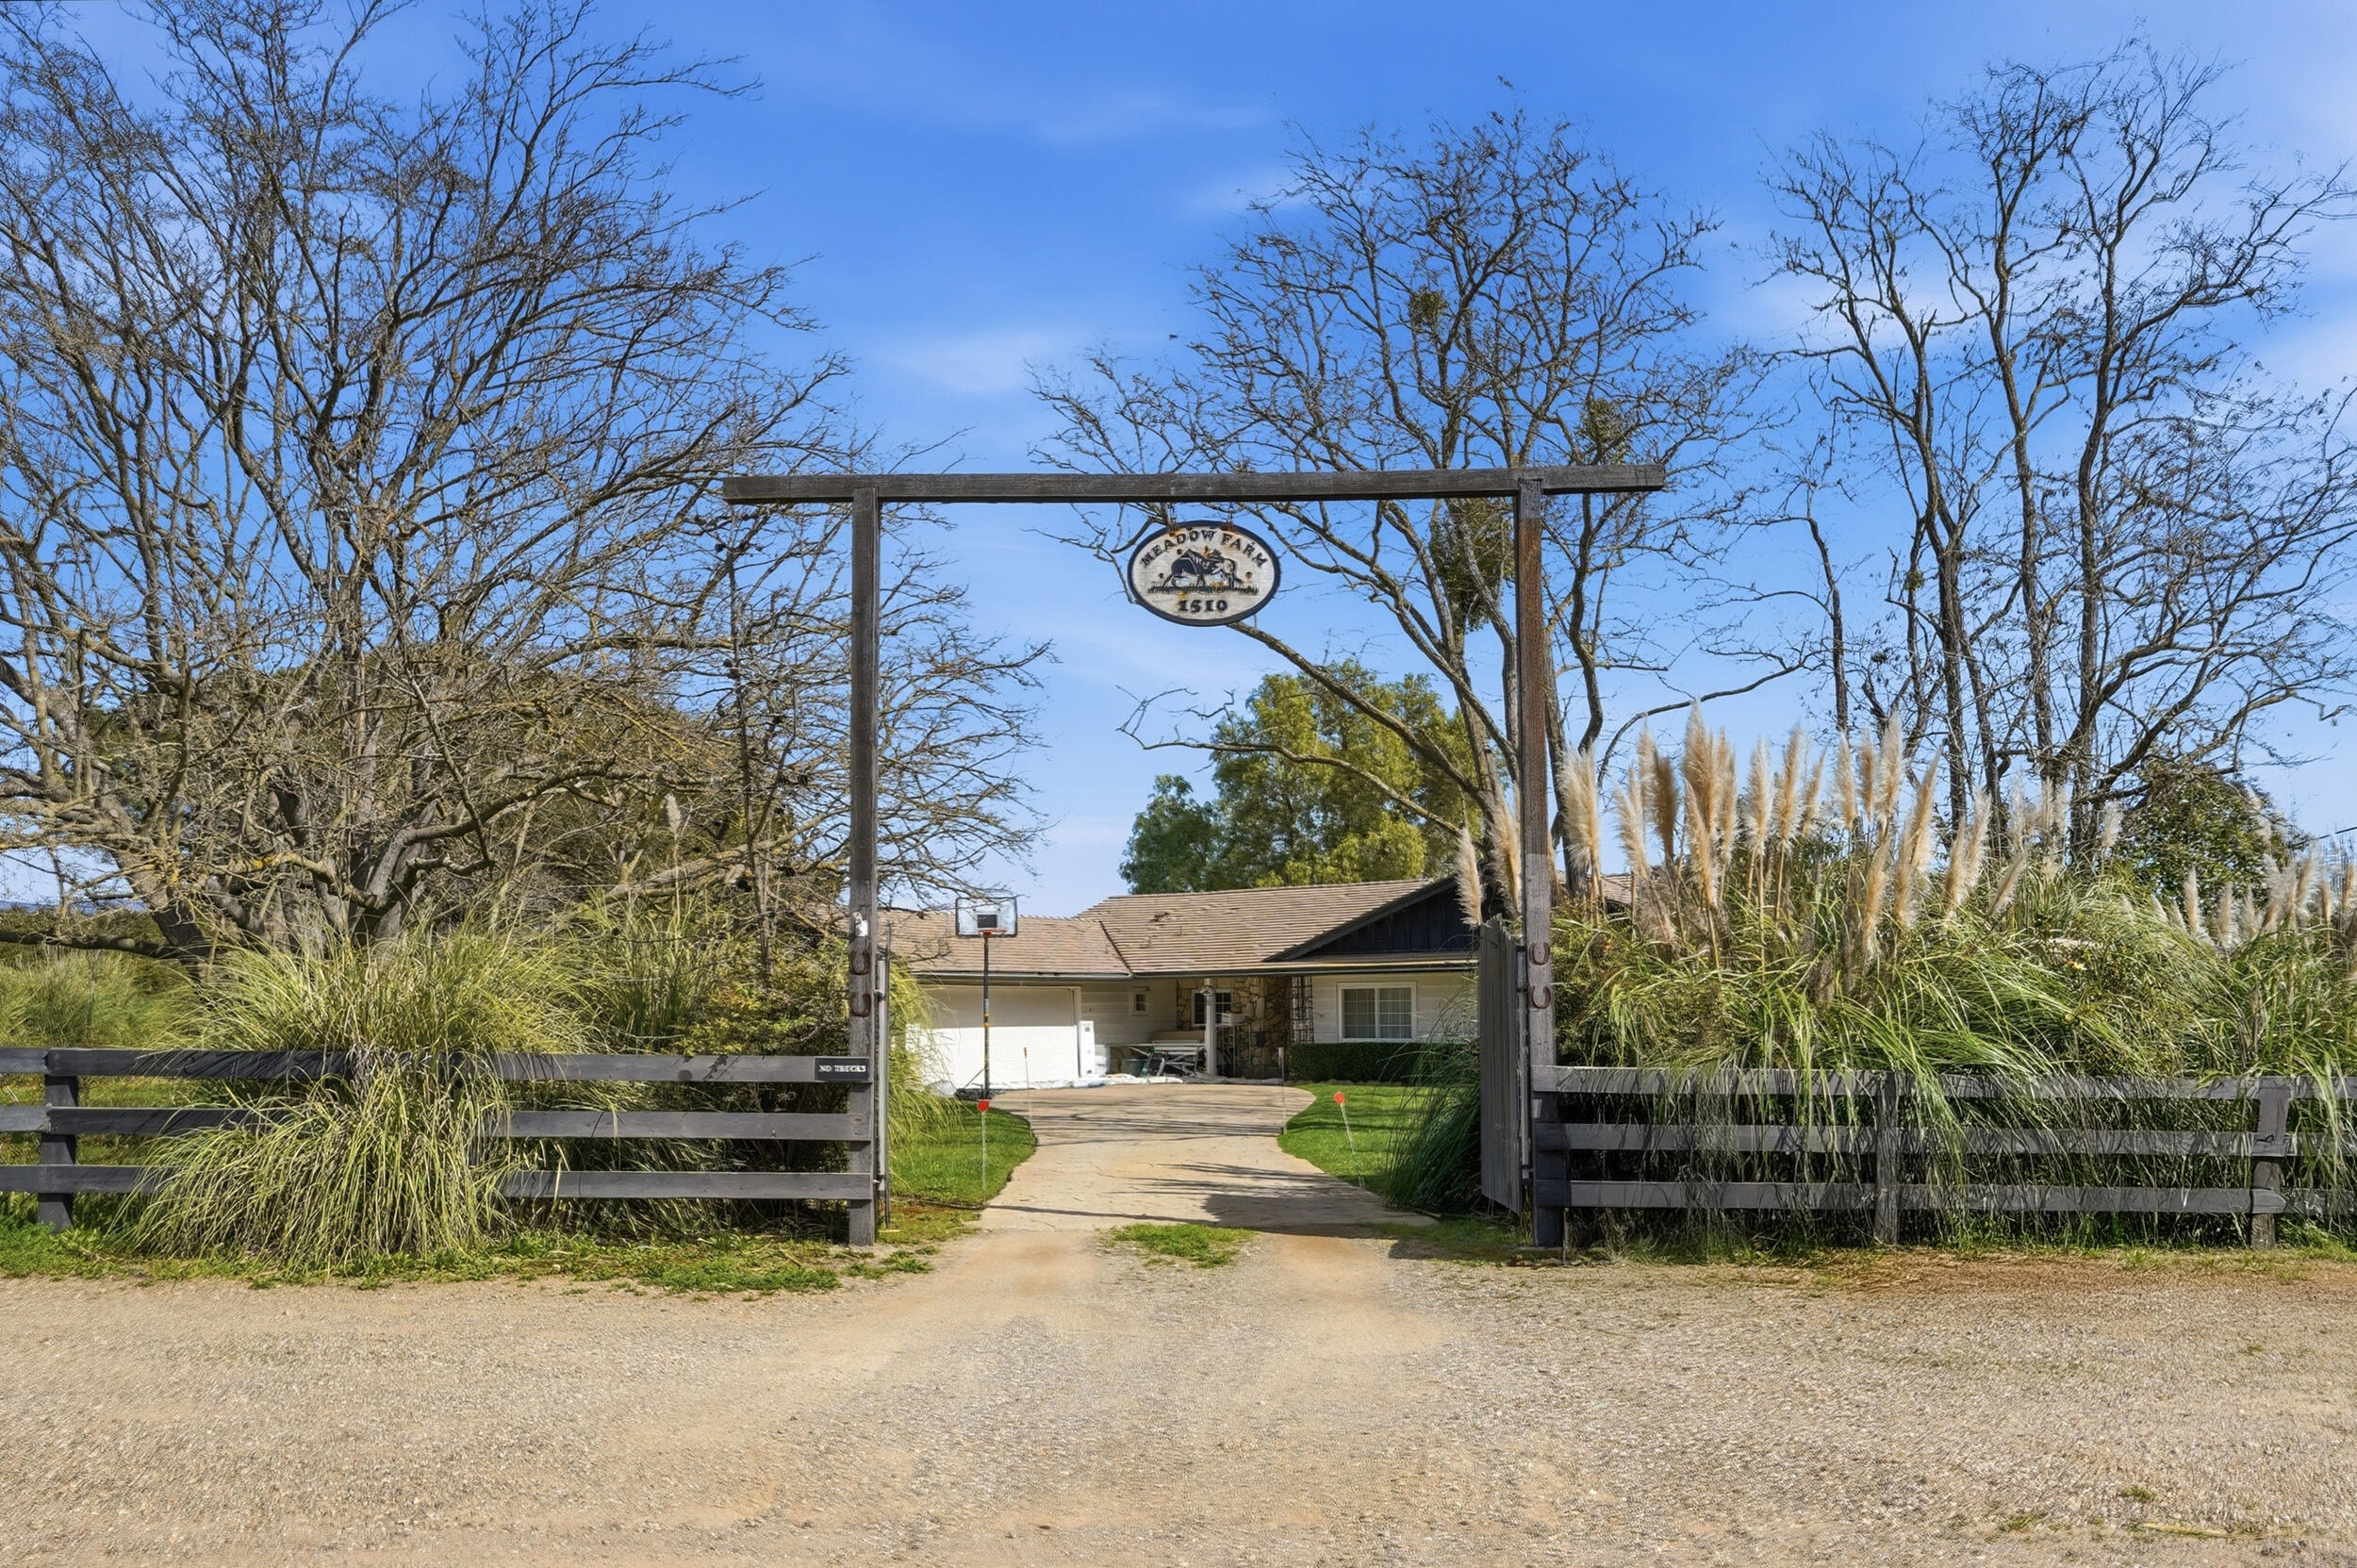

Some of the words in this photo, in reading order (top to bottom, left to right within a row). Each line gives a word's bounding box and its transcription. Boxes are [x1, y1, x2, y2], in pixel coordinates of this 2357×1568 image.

[1140, 529, 1217, 569] MEADOW
[1219, 532, 1268, 569] FARM
[1177, 598, 1228, 614] 1510
